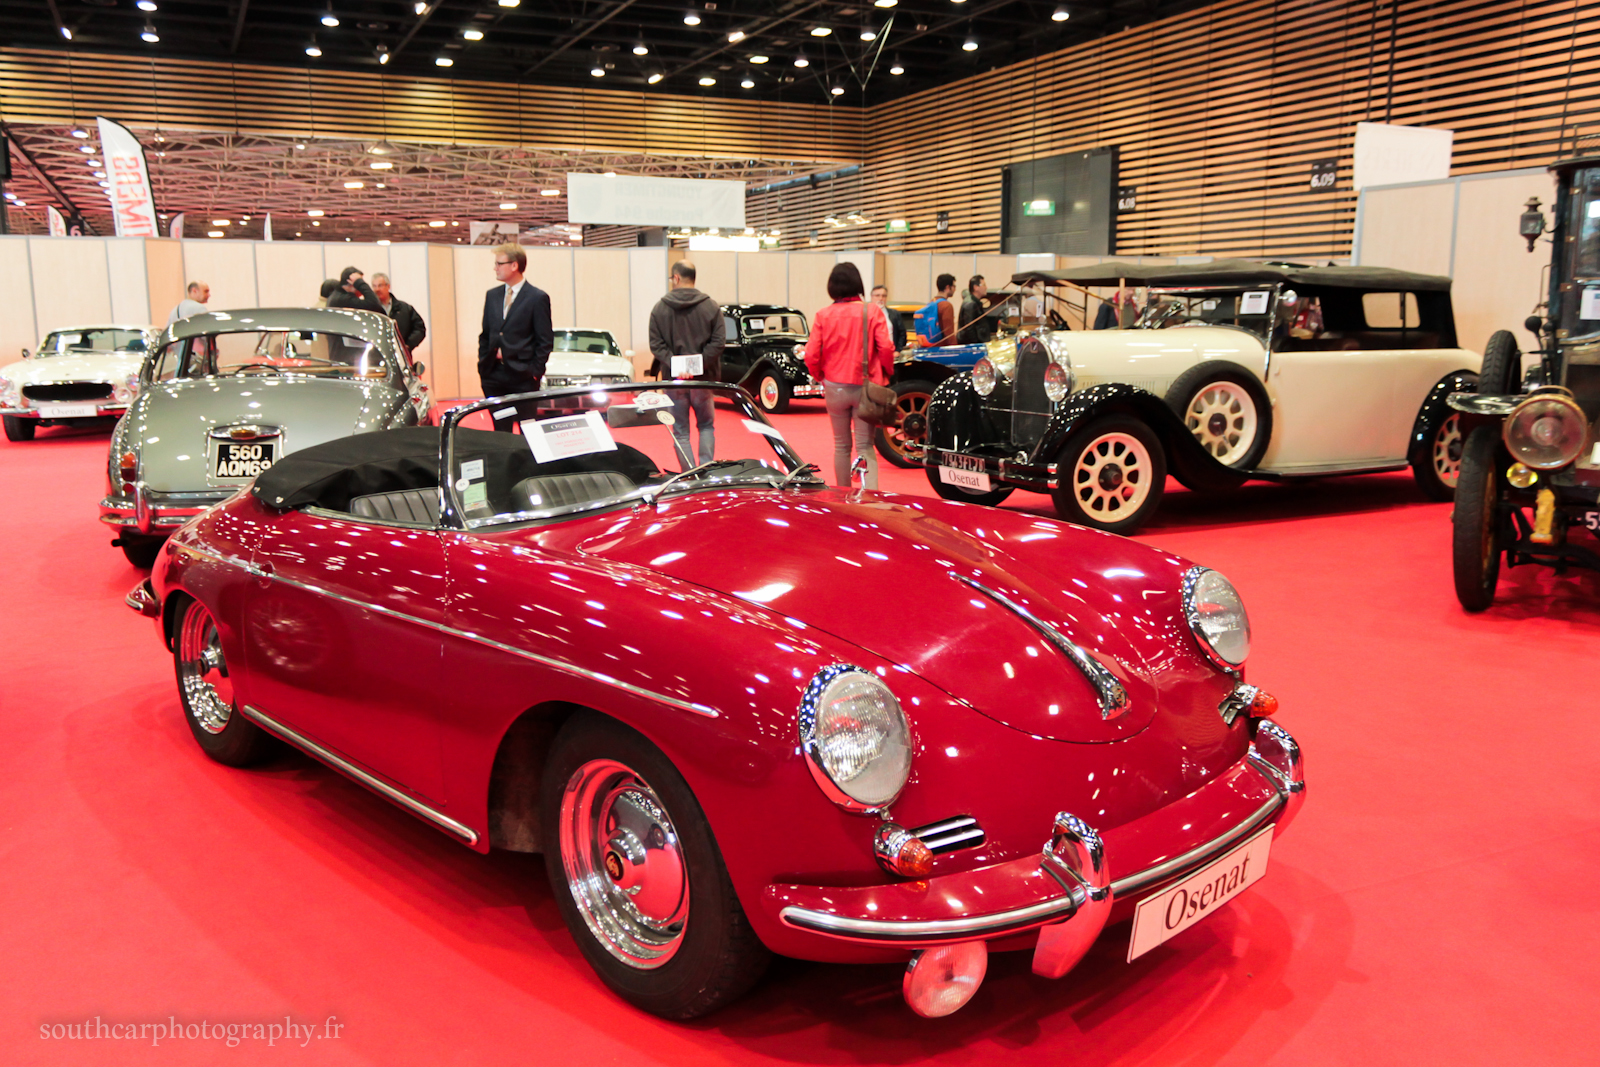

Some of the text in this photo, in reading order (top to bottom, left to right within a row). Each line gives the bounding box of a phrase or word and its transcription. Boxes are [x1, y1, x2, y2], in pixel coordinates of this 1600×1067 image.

[1310, 172, 1335, 188] 6.09
[51, 408, 85, 416] Osenat
[229, 445, 262, 460] 560
[948, 469, 980, 487] Osenat
[1165, 851, 1250, 930] Osenat
